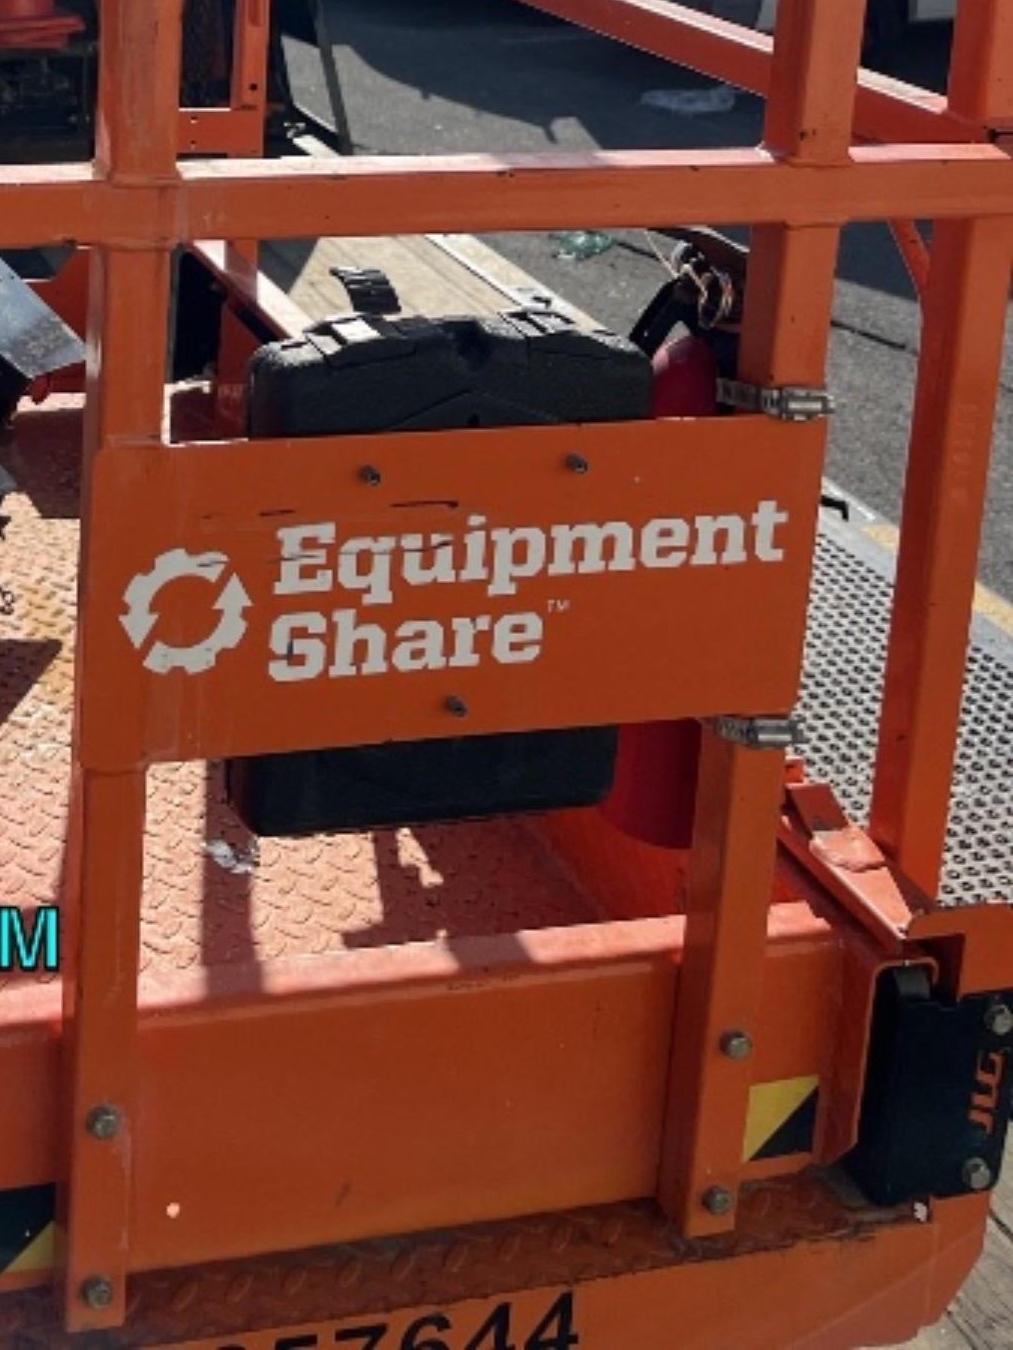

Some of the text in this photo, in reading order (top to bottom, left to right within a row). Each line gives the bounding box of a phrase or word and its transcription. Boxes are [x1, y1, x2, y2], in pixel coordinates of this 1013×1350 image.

[273, 500, 788, 605] Equipment
[268, 607, 544, 682] Share
[967, 1050, 1005, 1136] JLG
